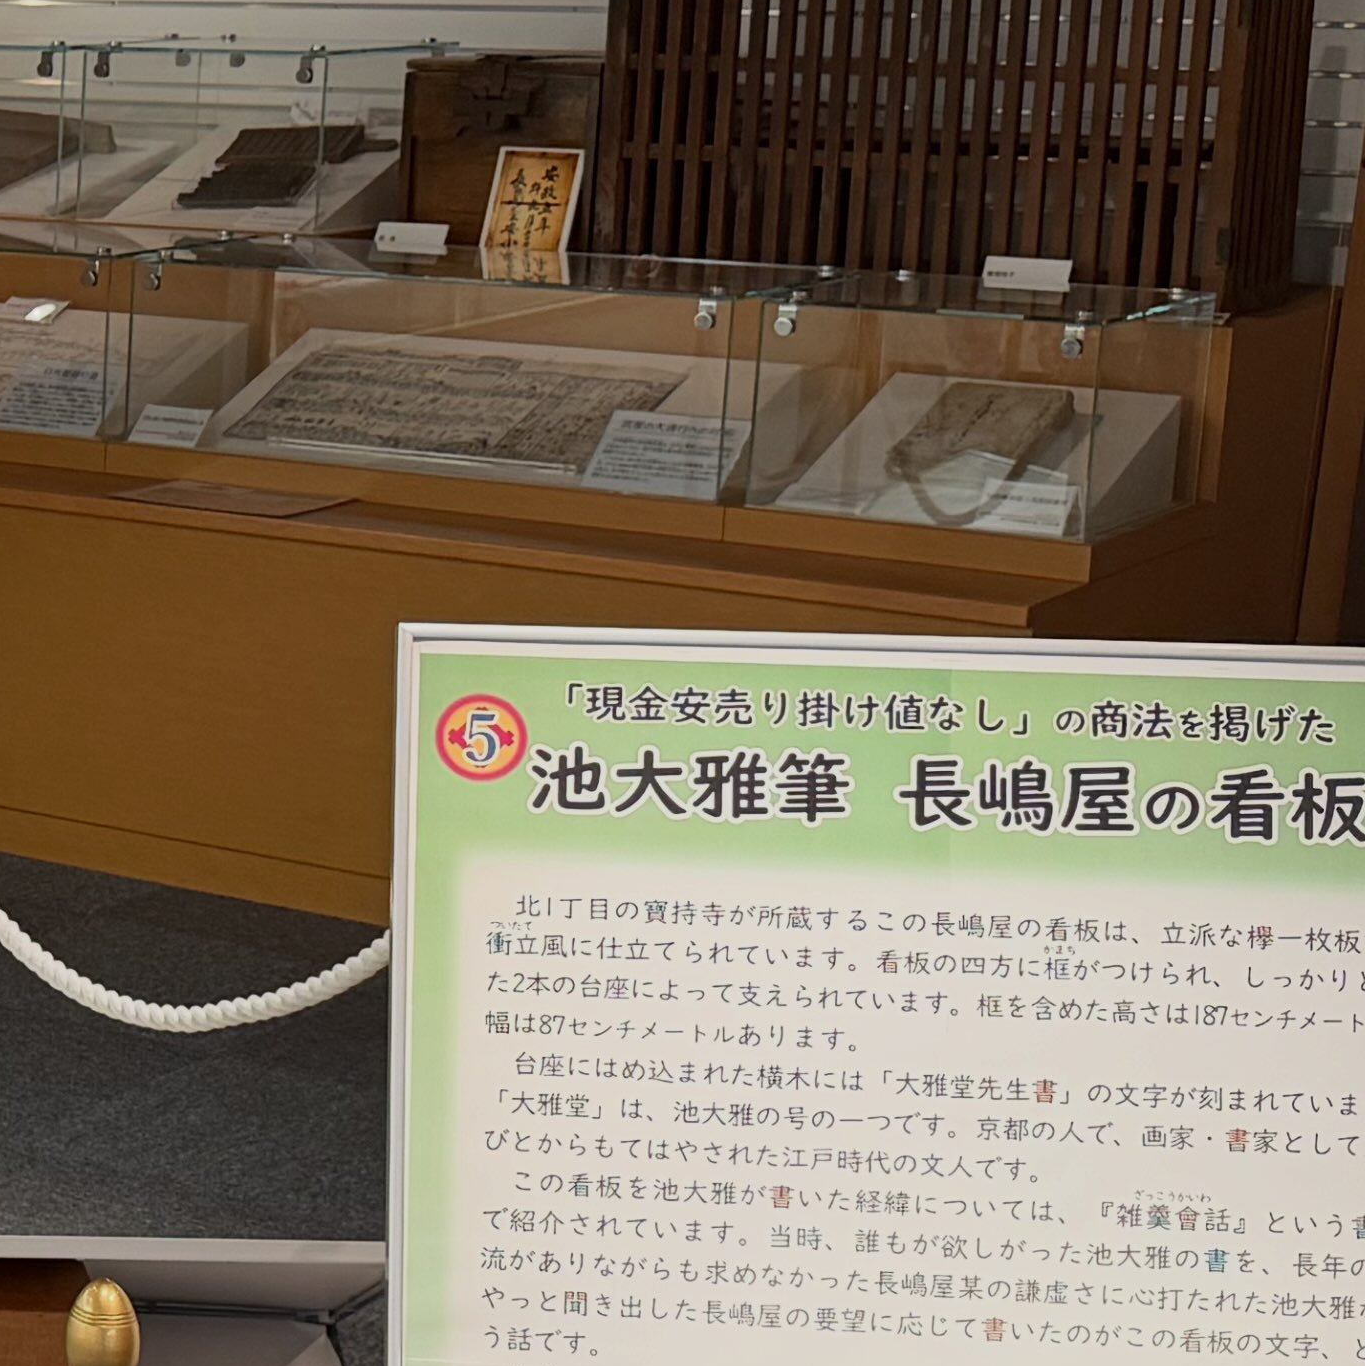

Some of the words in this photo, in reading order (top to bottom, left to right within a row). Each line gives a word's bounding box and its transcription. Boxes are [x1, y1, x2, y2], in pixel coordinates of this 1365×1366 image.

[460, 712, 500, 767] 5
[561, 683, 1337, 746] 「現金安売り掛け値なし」の商法を掲げた
[529, 748, 851, 823] 池大雅筆
[899, 760, 1365, 845] 長嶋屋の看板
[485, 1011, 858, 1052] 幅は87センチメートルあります。
[485, 1129, 1040, 1183] びとからもてはやされた江戸時代の文人です。
[480, 1246, 1365, 1320] 流がありながらも求めなかった長嶋屋某の謙虚さに心打たれた池大雅
[484, 1325, 600, 1357] う話です。
